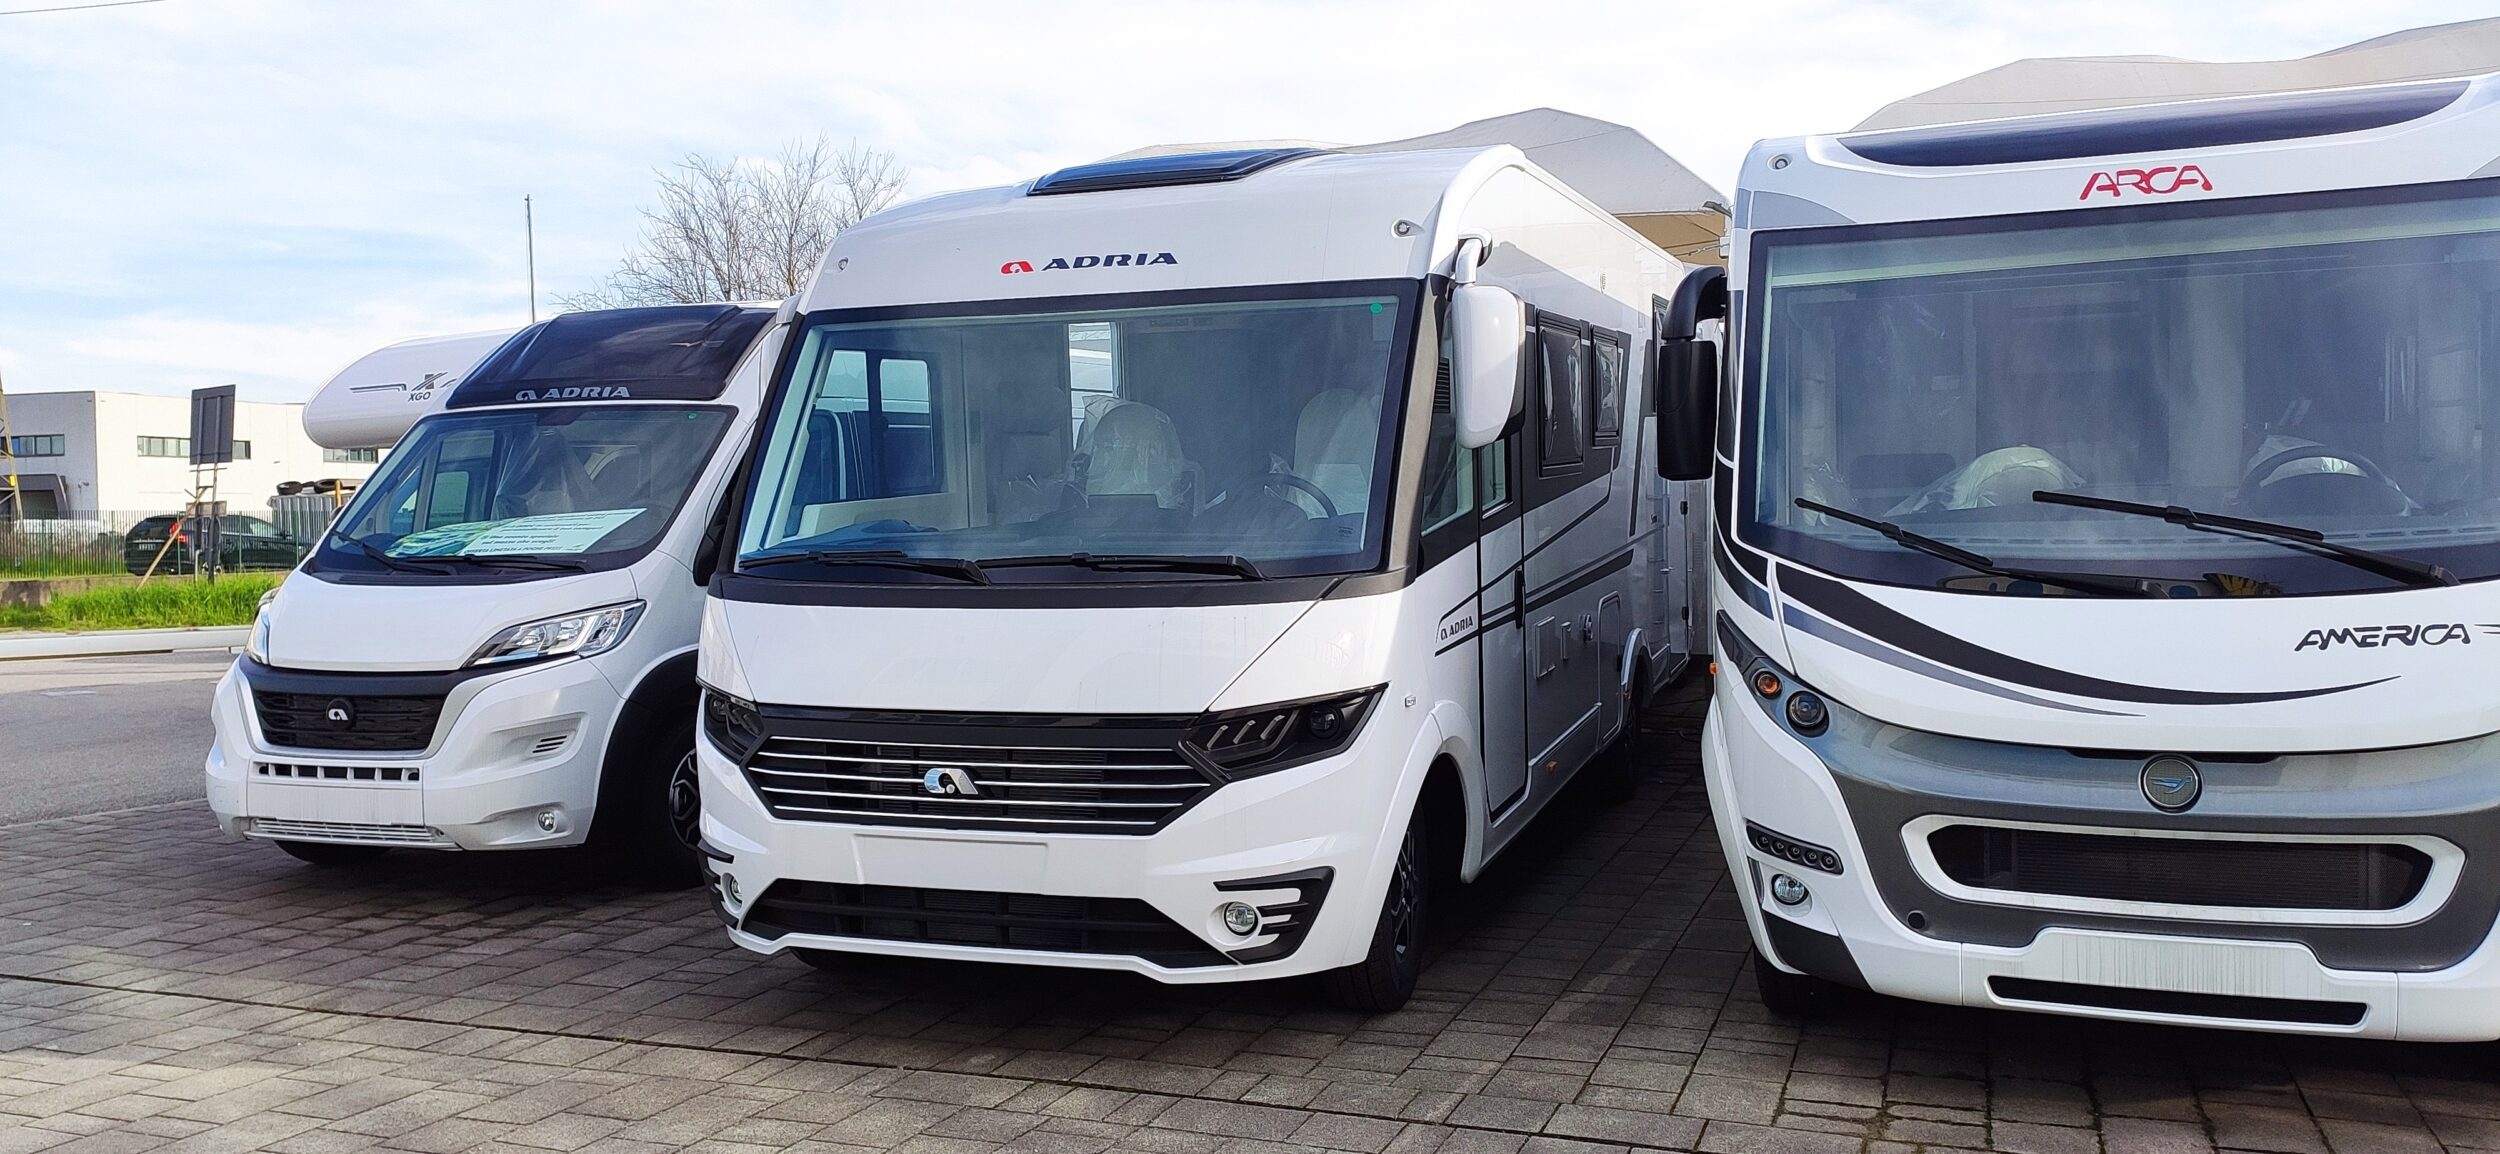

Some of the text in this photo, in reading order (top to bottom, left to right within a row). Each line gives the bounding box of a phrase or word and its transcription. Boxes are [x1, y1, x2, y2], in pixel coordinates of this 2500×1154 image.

[2079, 165, 2213, 201] ARCA
[1041, 252, 1178, 271] ADRIA
[407, 391, 431, 402] XGO
[541, 386, 631, 400] ADRIA
[1449, 616, 1473, 637] ADRIA
[2294, 623, 2471, 652] AMERICA
